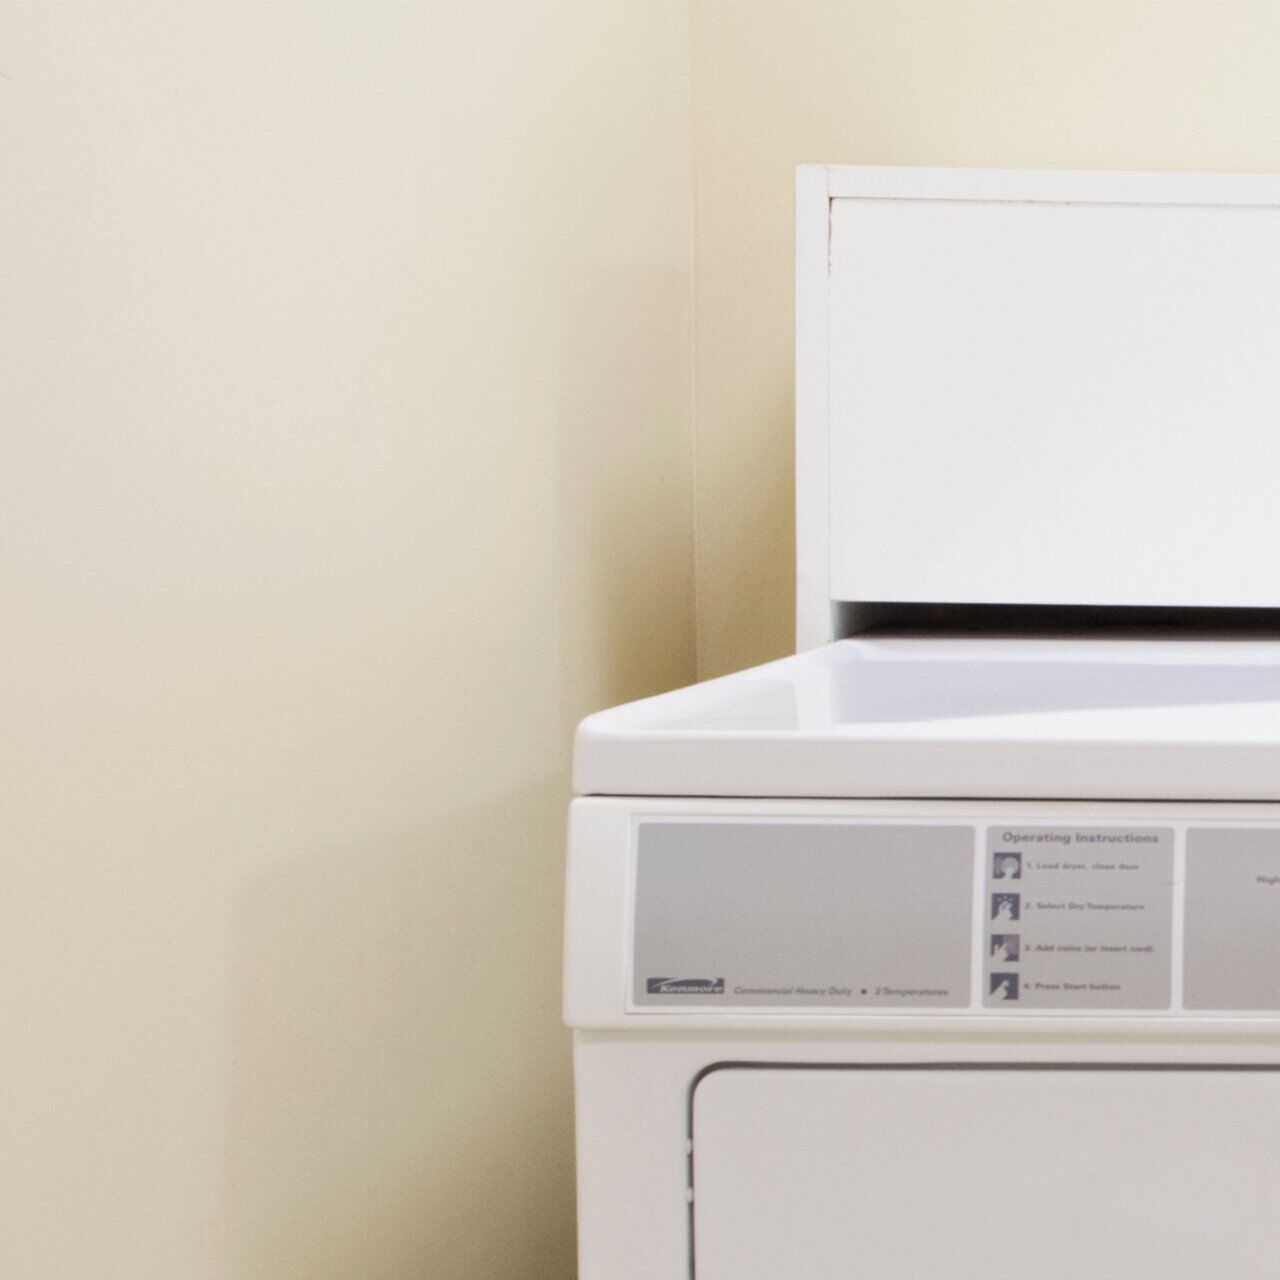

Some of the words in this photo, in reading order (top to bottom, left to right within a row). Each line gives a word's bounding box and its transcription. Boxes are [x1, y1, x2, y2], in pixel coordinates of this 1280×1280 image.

[1002, 832, 1072, 845] Operating
[1076, 832, 1160, 844] Instructions
[1257, 876, 1280, 885] High
[1087, 903, 1144, 912] Temperature
[660, 985, 724, 993] Kenmore
[733, 986, 793, 995] Commercial
[795, 986, 826, 997] Heavy
[829, 986, 852, 997] Duty
[883, 987, 949, 998] Temperatures
